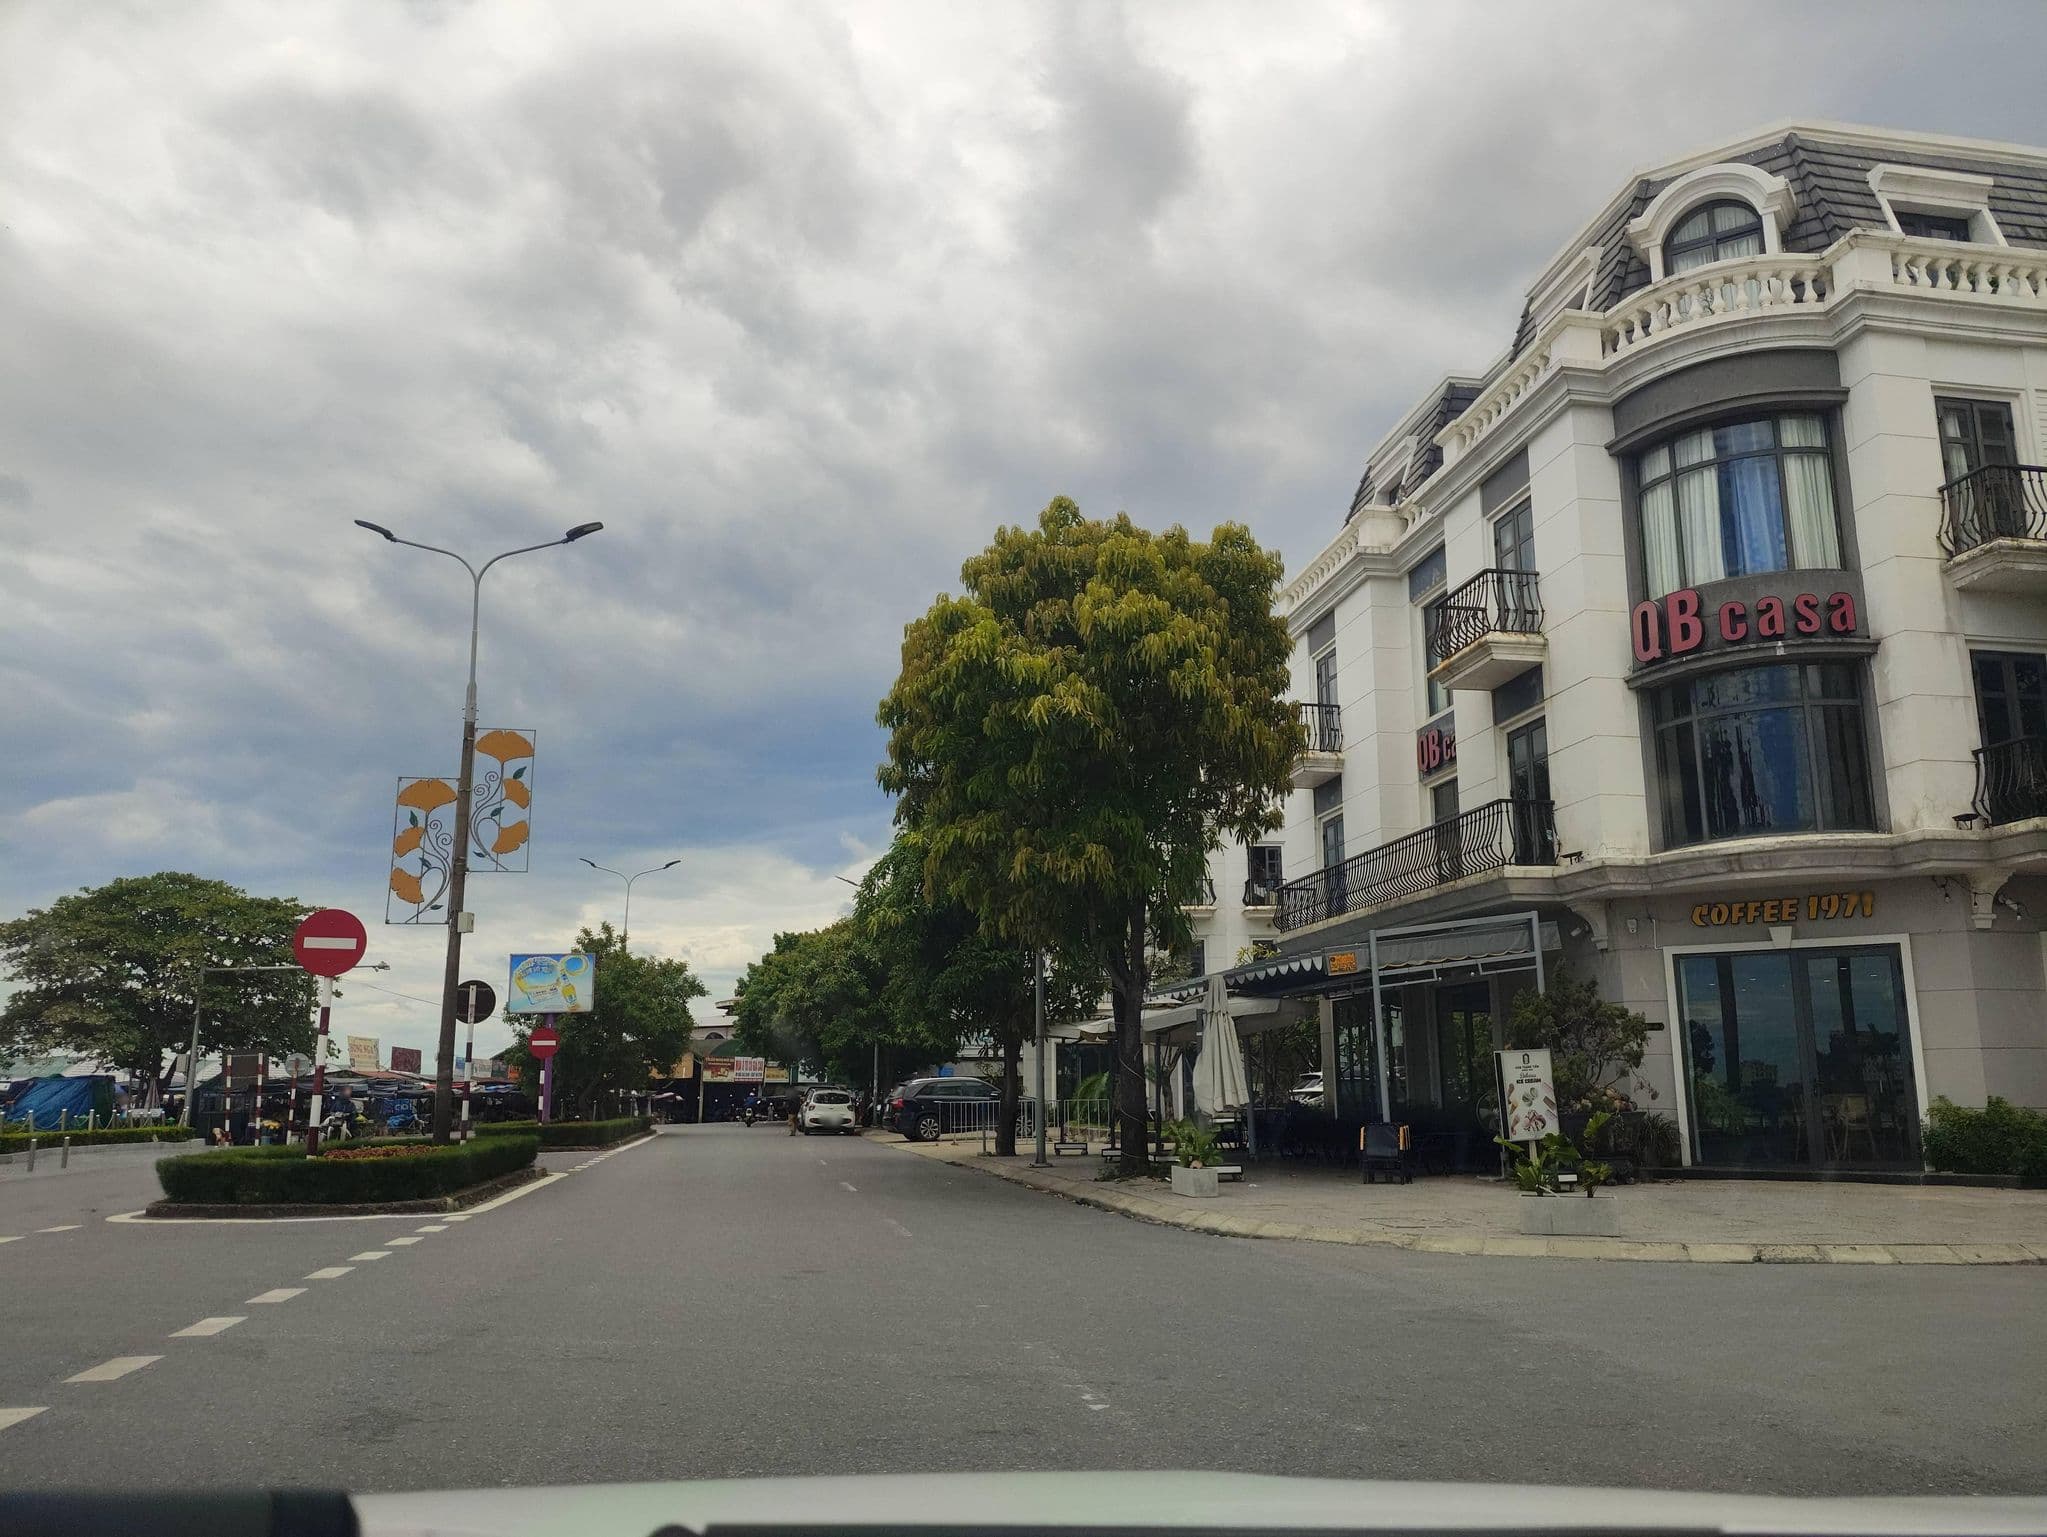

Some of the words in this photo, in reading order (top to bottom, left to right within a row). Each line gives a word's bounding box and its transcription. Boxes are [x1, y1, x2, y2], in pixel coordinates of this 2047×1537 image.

[1633, 589, 1704, 662] QB
[1719, 592, 1856, 641] casa
[1417, 729, 1440, 772] QB
[1691, 898, 1798, 926] COFFEE
[1808, 890, 1874, 919] 1971
